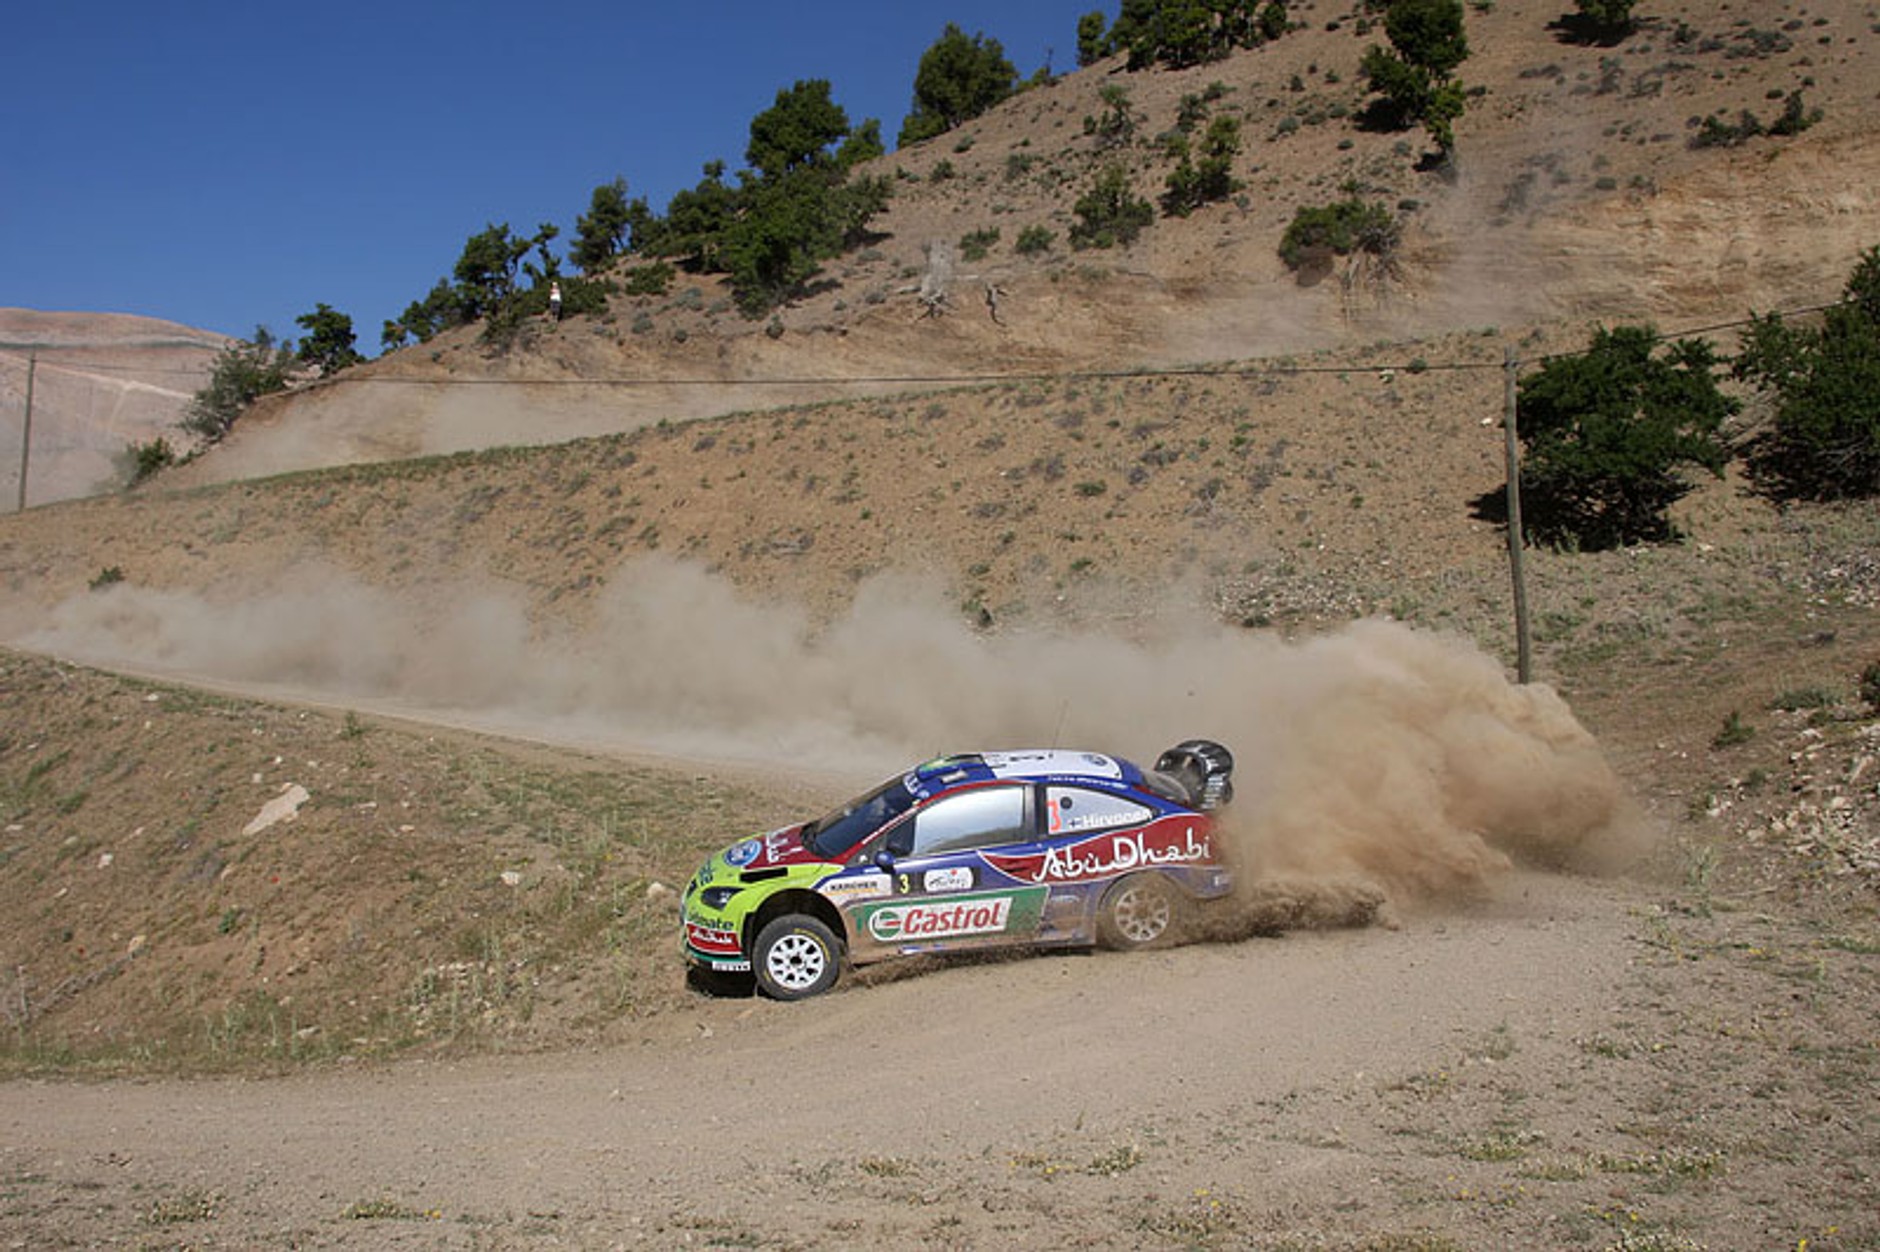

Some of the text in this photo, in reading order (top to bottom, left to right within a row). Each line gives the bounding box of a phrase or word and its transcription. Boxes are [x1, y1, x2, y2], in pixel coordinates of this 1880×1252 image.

[1047, 800, 1061, 831] 3
[900, 873, 910, 894] 3
[904, 902, 1001, 934] Castrol
